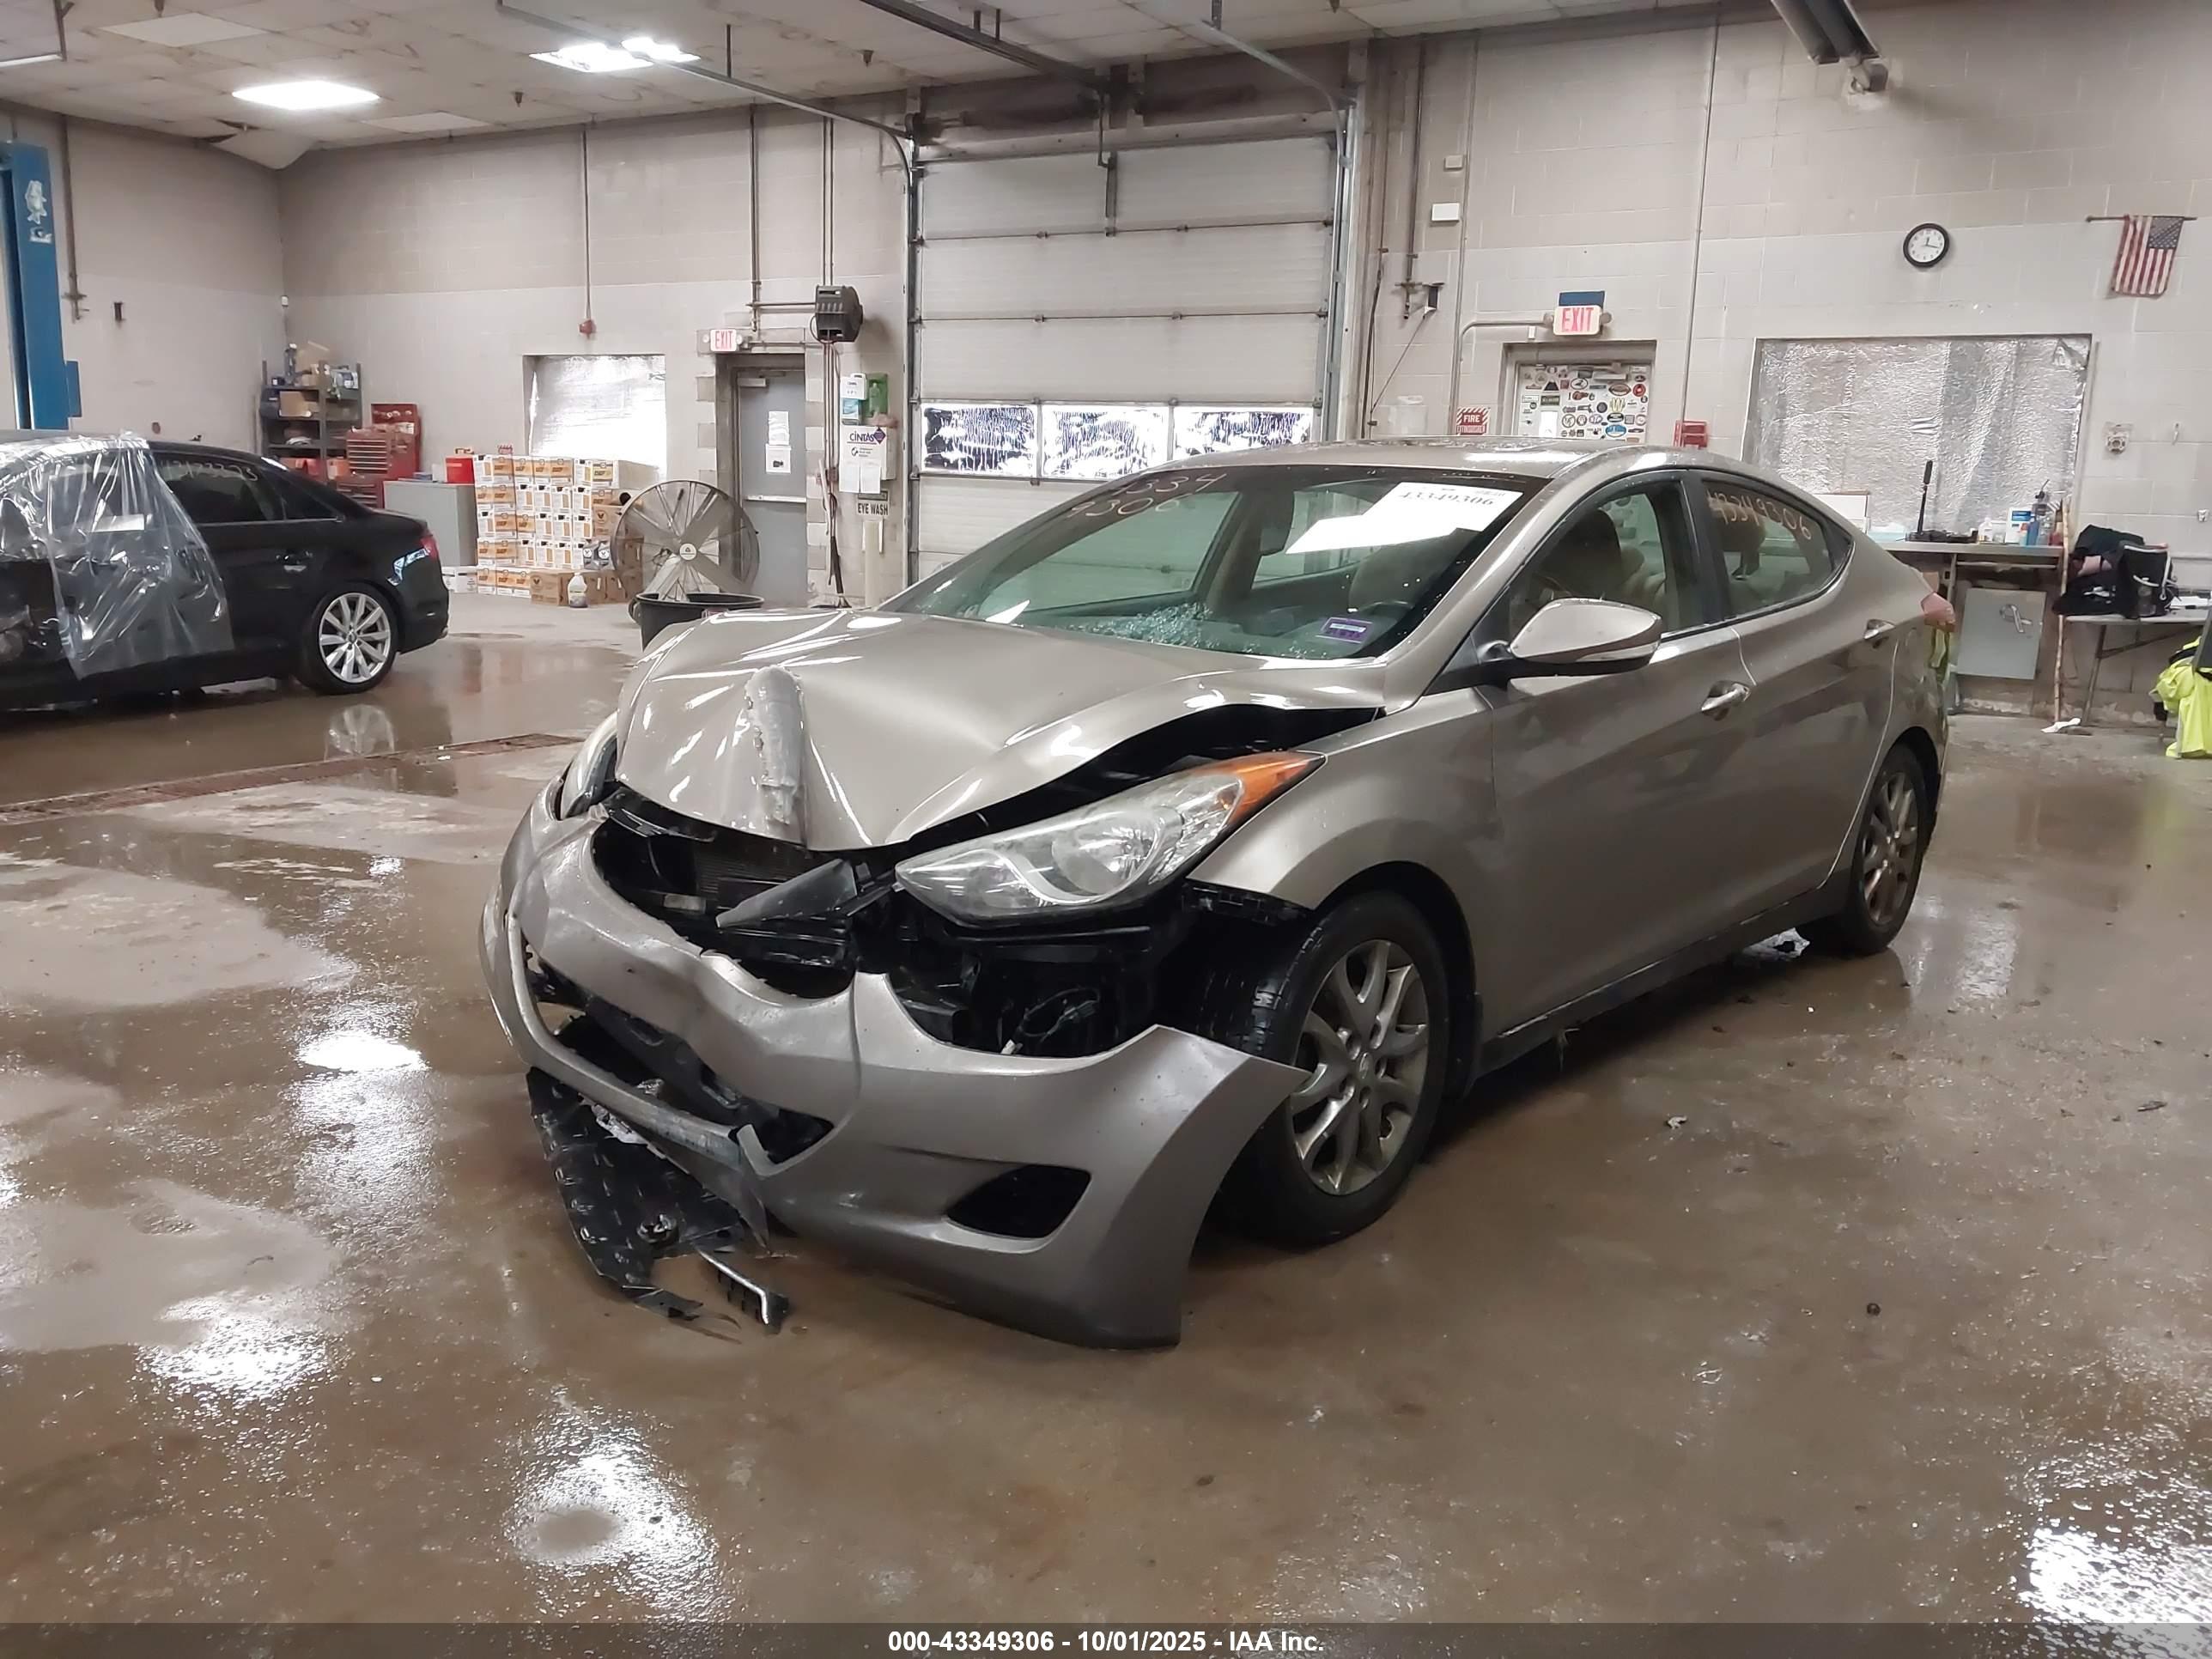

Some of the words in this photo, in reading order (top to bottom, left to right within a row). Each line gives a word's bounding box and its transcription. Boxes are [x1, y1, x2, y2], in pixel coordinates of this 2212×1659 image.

[1561, 307, 1595, 332] EXIT
[714, 330, 733, 349] EXIT
[1463, 414, 1480, 423] FIRE
[858, 502, 869, 514] EYE
[871, 503, 889, 516] WASH
